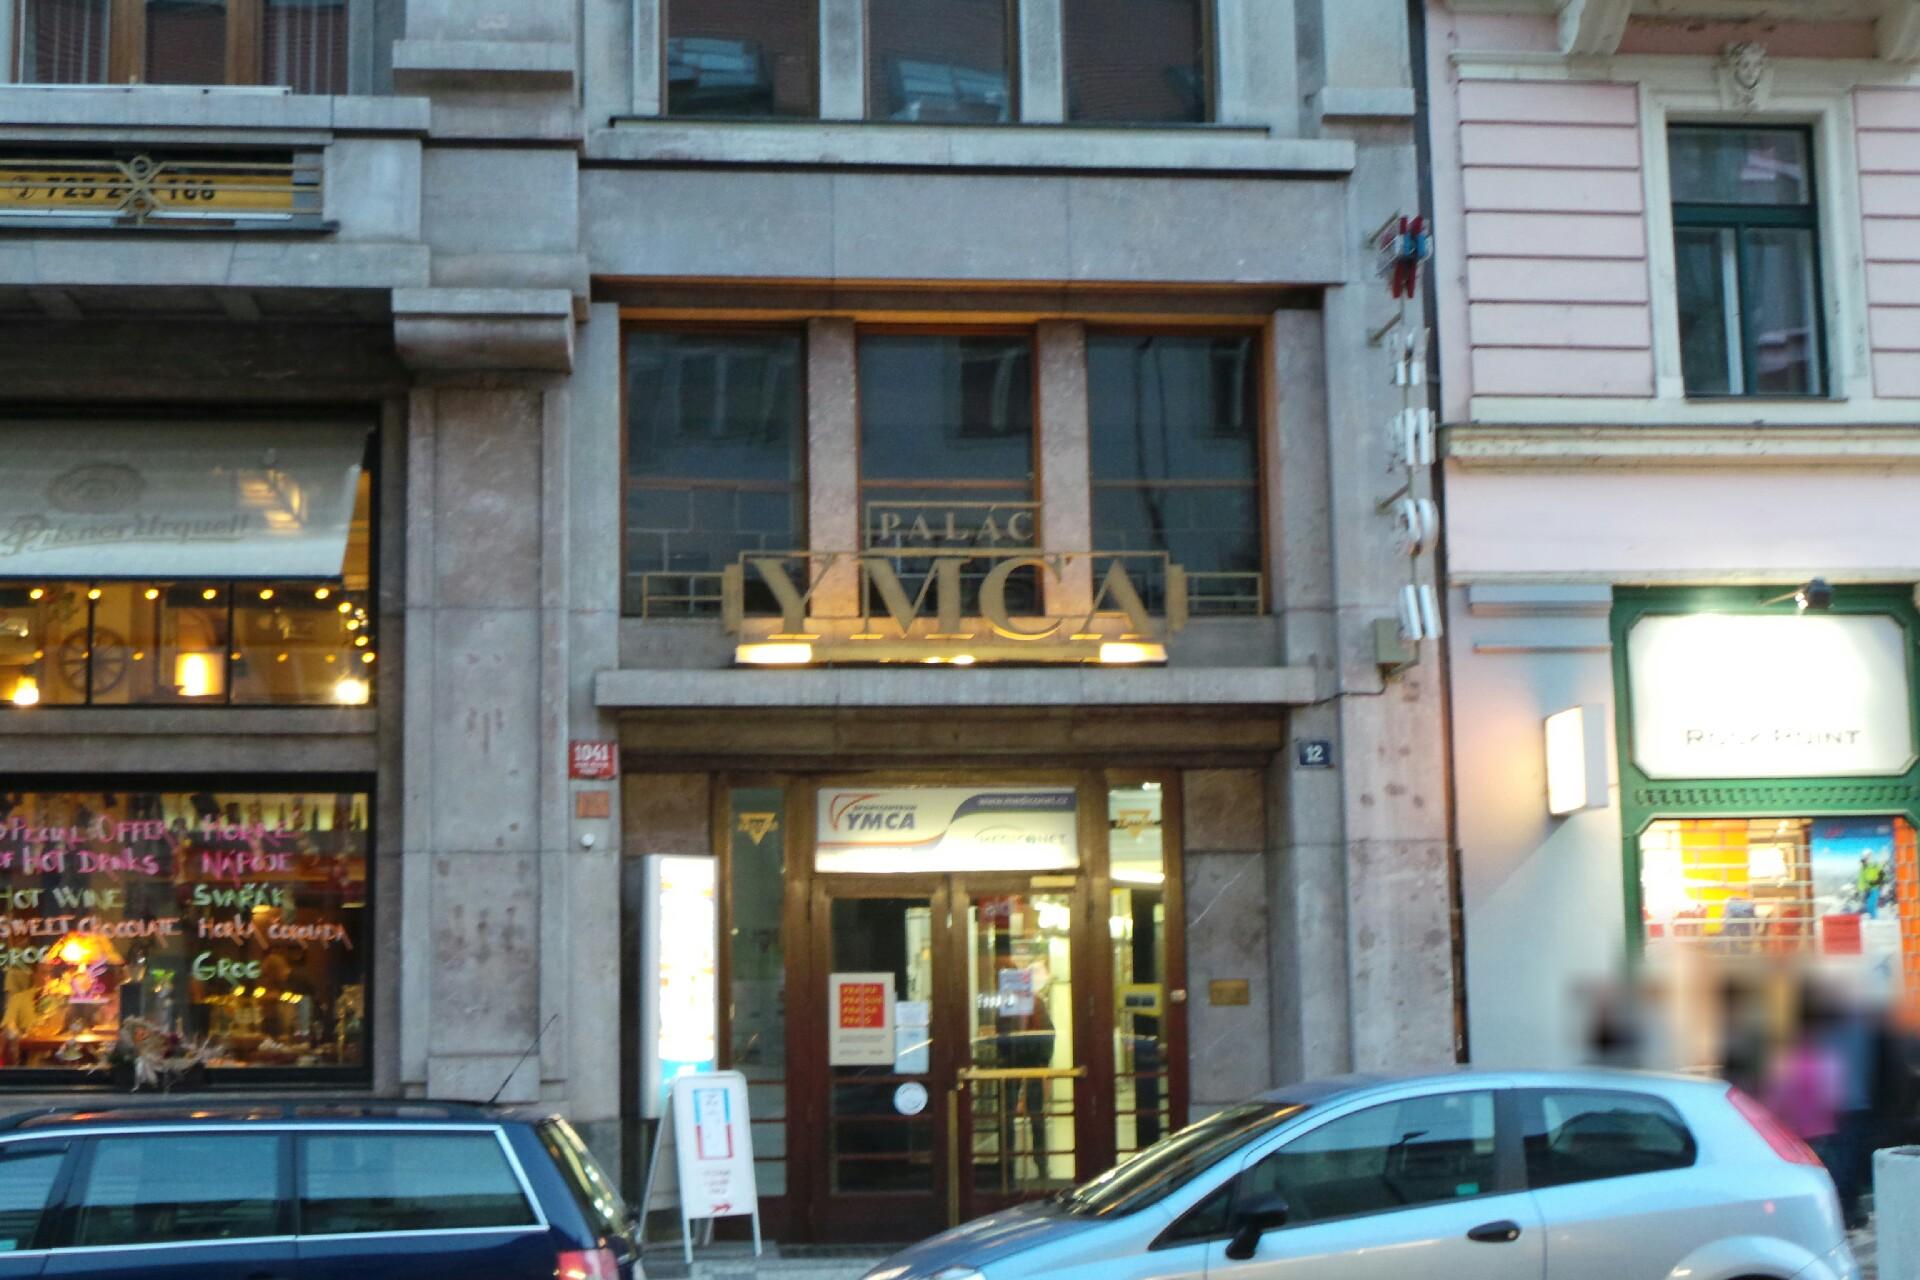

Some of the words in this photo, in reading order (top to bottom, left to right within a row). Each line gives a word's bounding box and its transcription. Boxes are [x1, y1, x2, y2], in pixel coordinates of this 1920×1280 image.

[880, 505, 1033, 541] PALÁC
[752, 556, 1157, 641] YMCA
[1306, 744, 1325, 762] 12
[846, 812, 917, 831] YMCA
